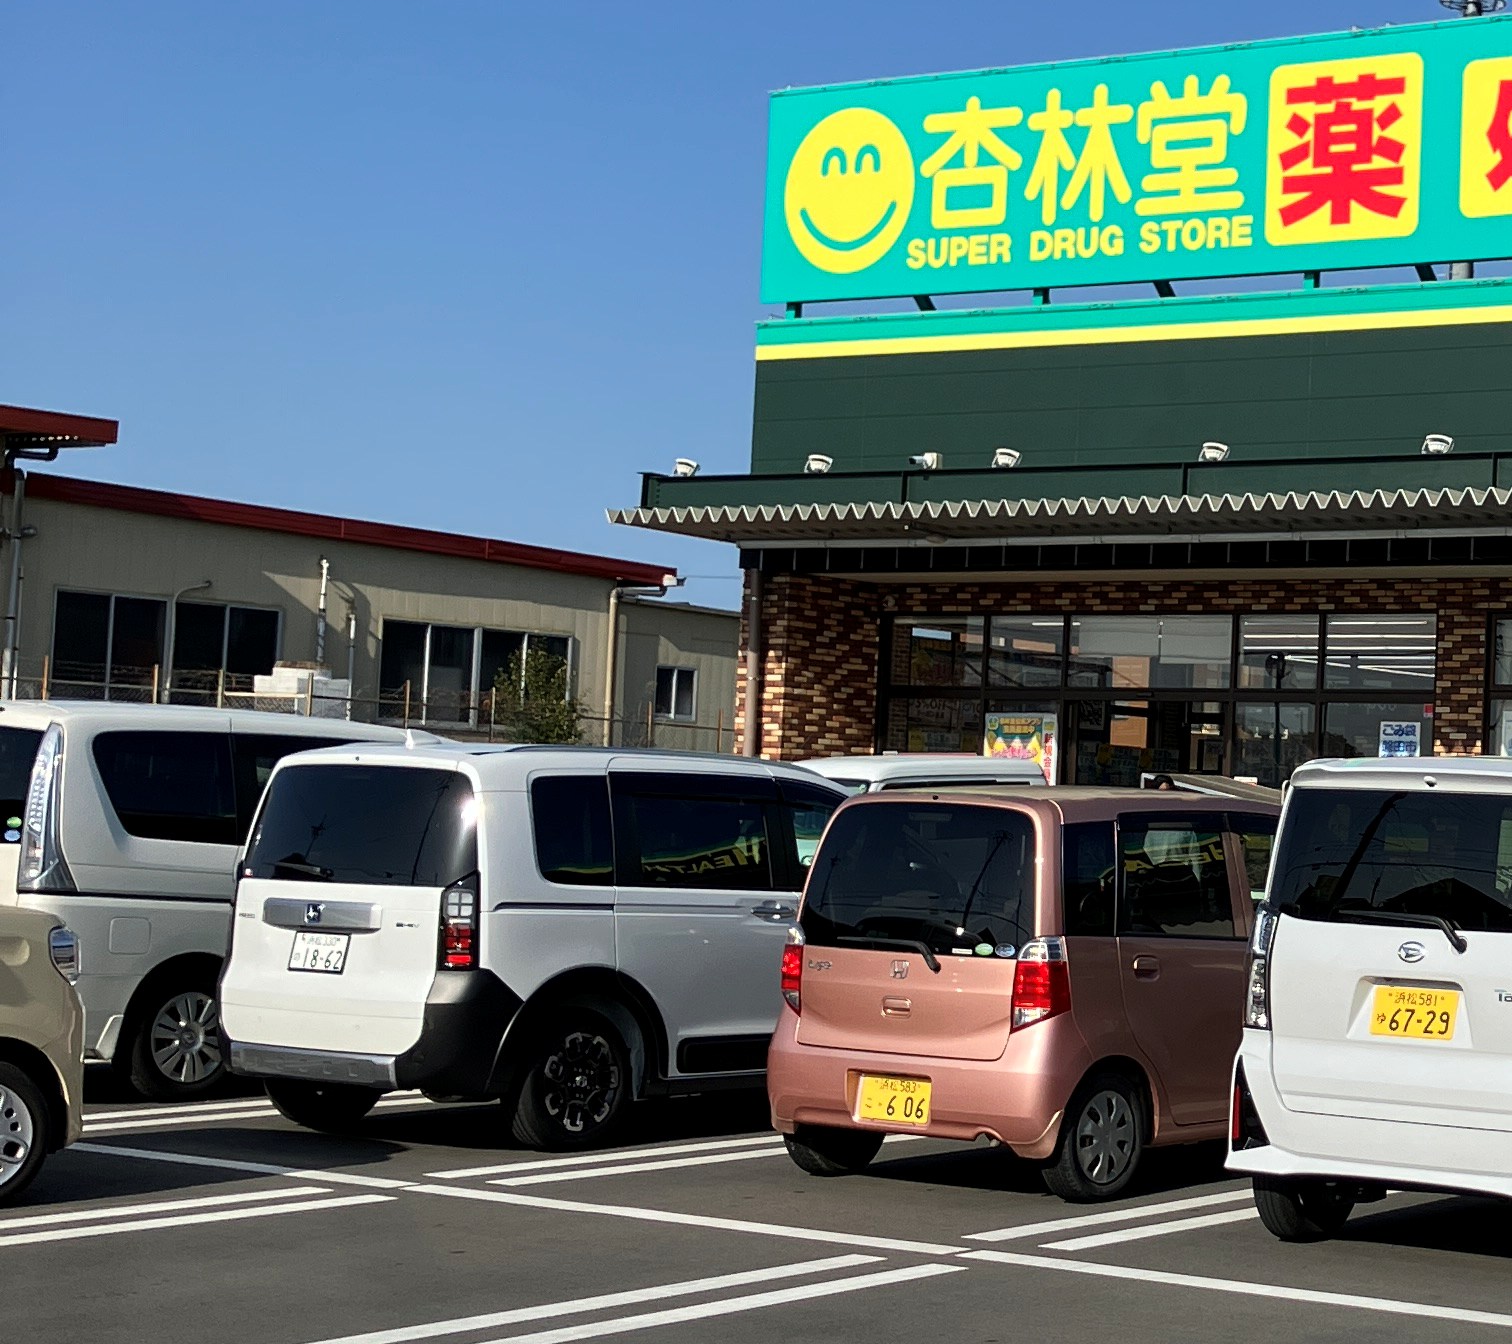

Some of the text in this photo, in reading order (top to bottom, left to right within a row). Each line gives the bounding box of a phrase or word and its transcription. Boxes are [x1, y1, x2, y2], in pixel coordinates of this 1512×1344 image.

[920, 73, 1248, 230] 杏林堂
[1278, 71, 1408, 228] 薬
[906, 214, 1254, 270] SUPER DRUG STORE
[1382, 723, 1417, 737] ごみ袋
[1388, 1008, 1451, 1036] 67-29
